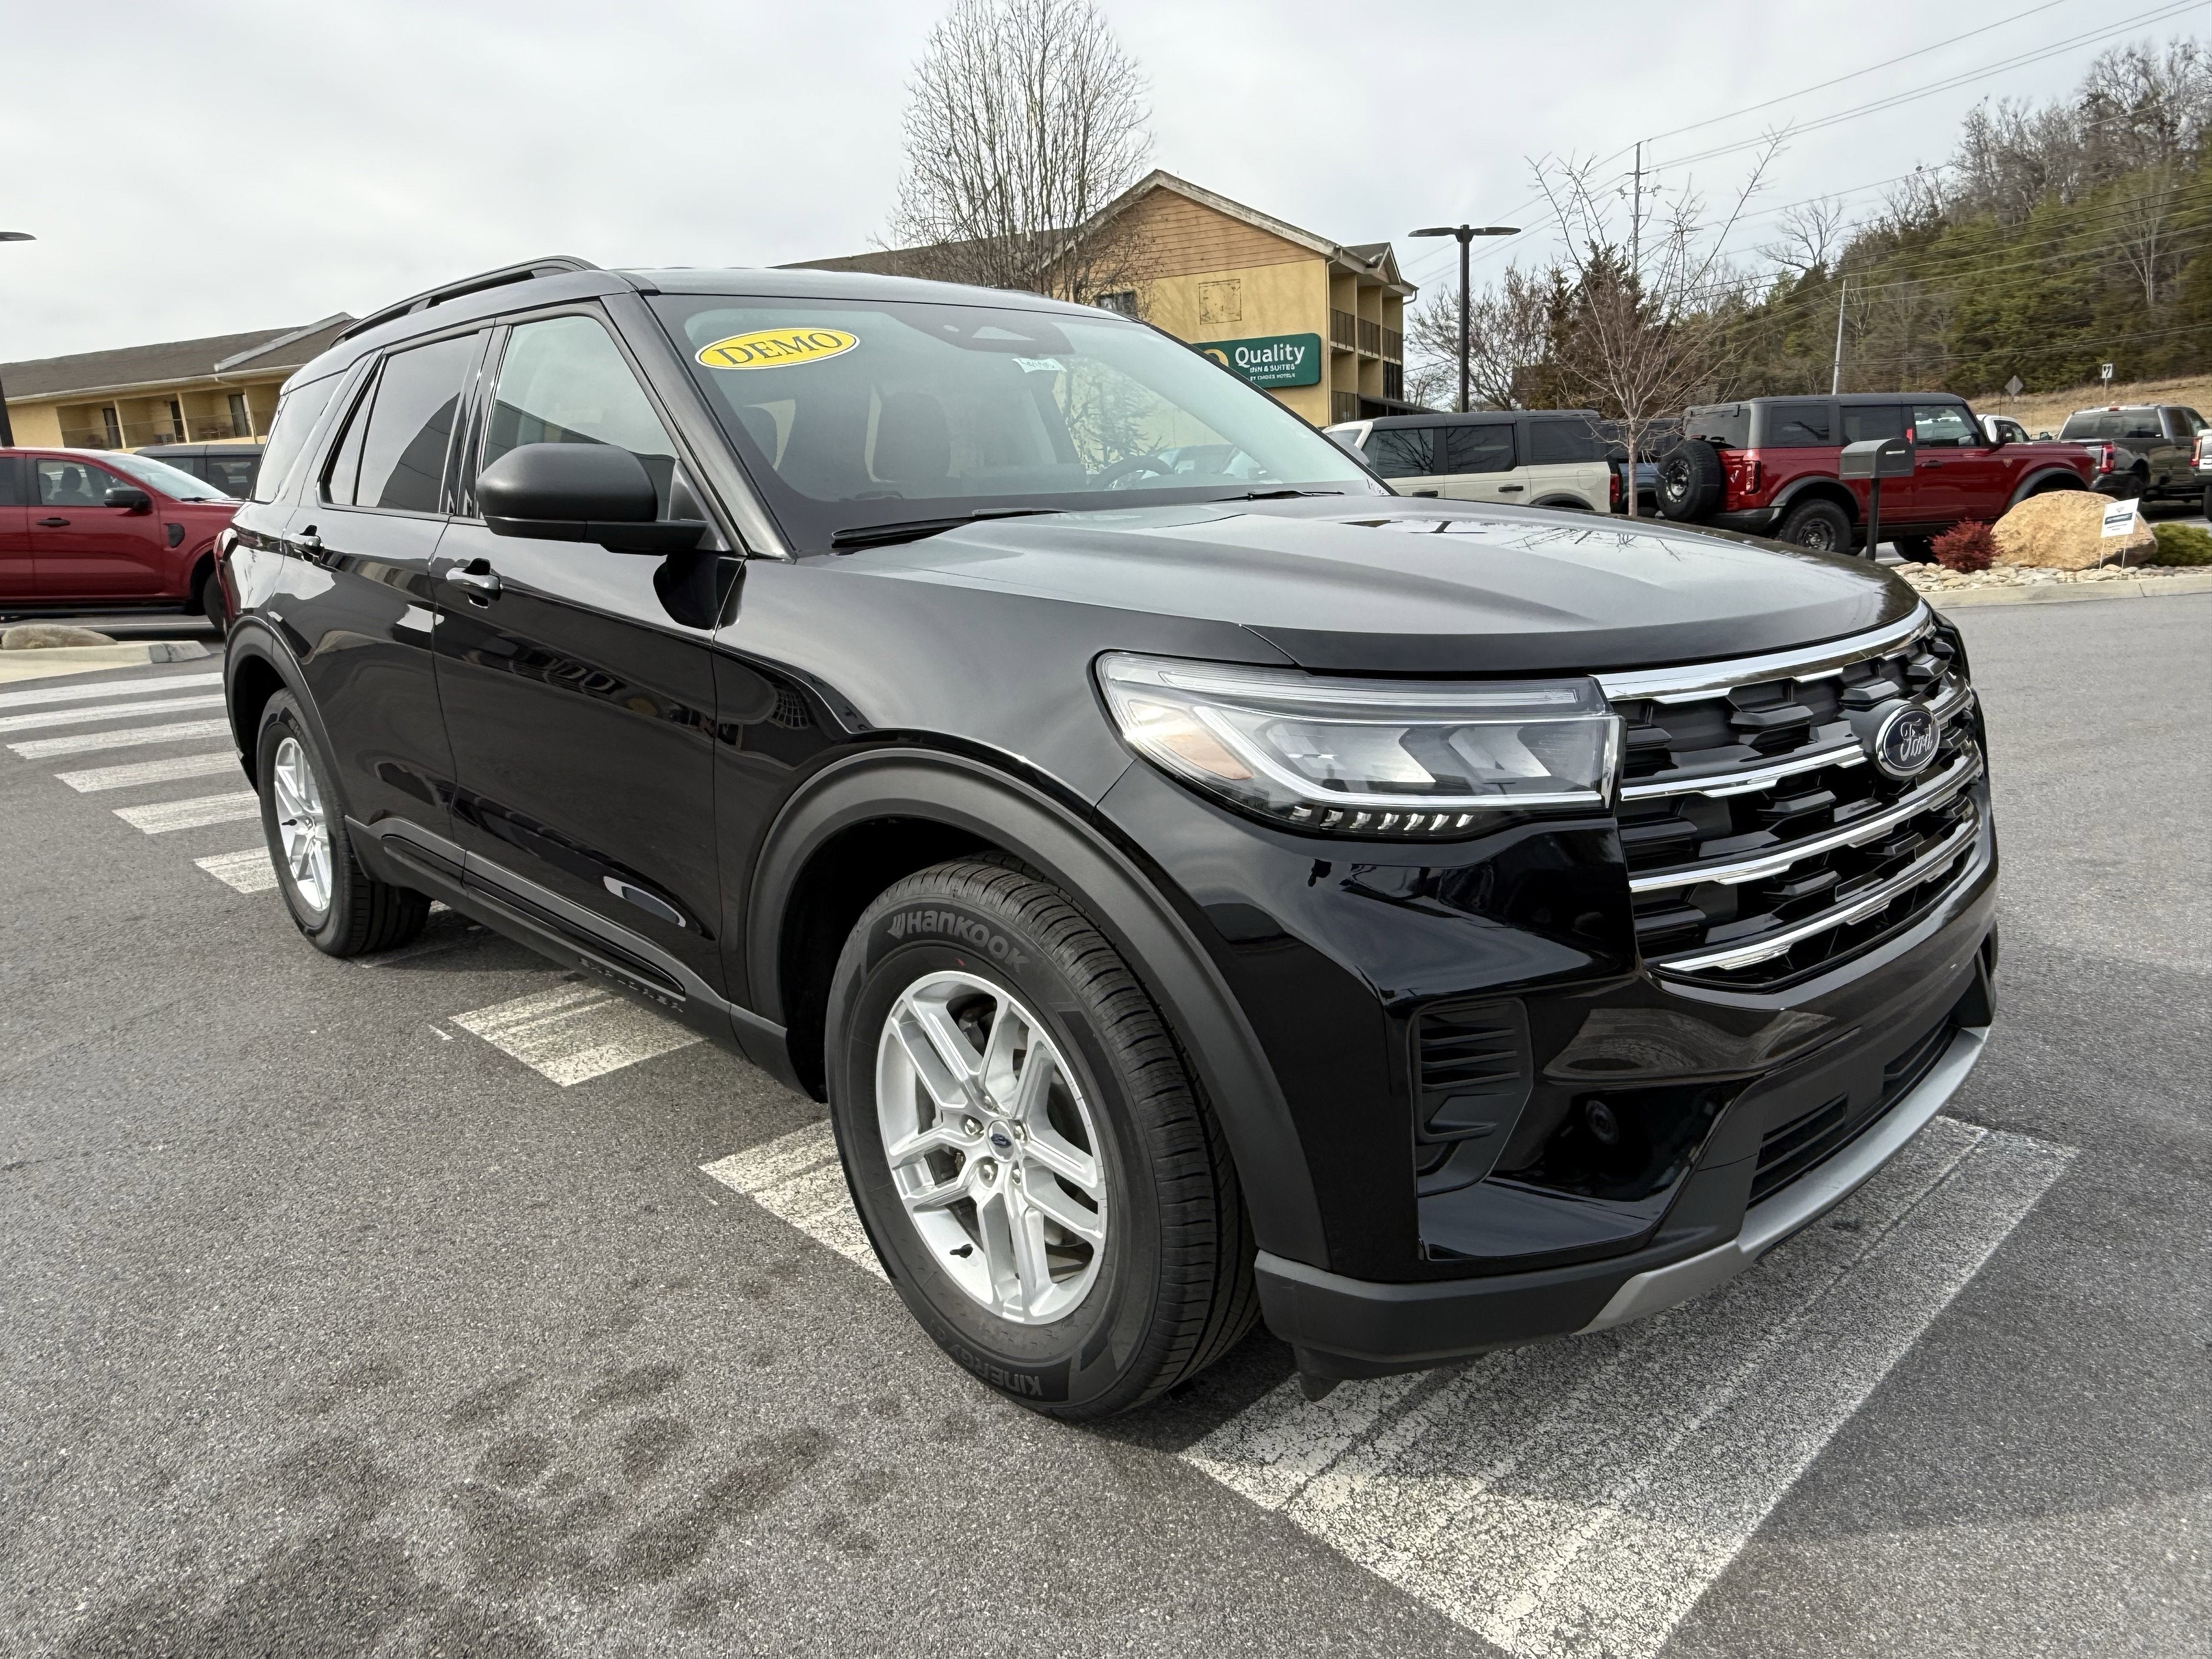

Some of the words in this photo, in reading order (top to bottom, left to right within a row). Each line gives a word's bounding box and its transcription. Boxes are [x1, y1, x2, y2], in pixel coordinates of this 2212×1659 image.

[712, 332, 843, 365] DEMO
[1235, 343, 1305, 368] Quality
[1269, 363, 1295, 371] SUITES
[1900, 718, 1933, 761] Ford
